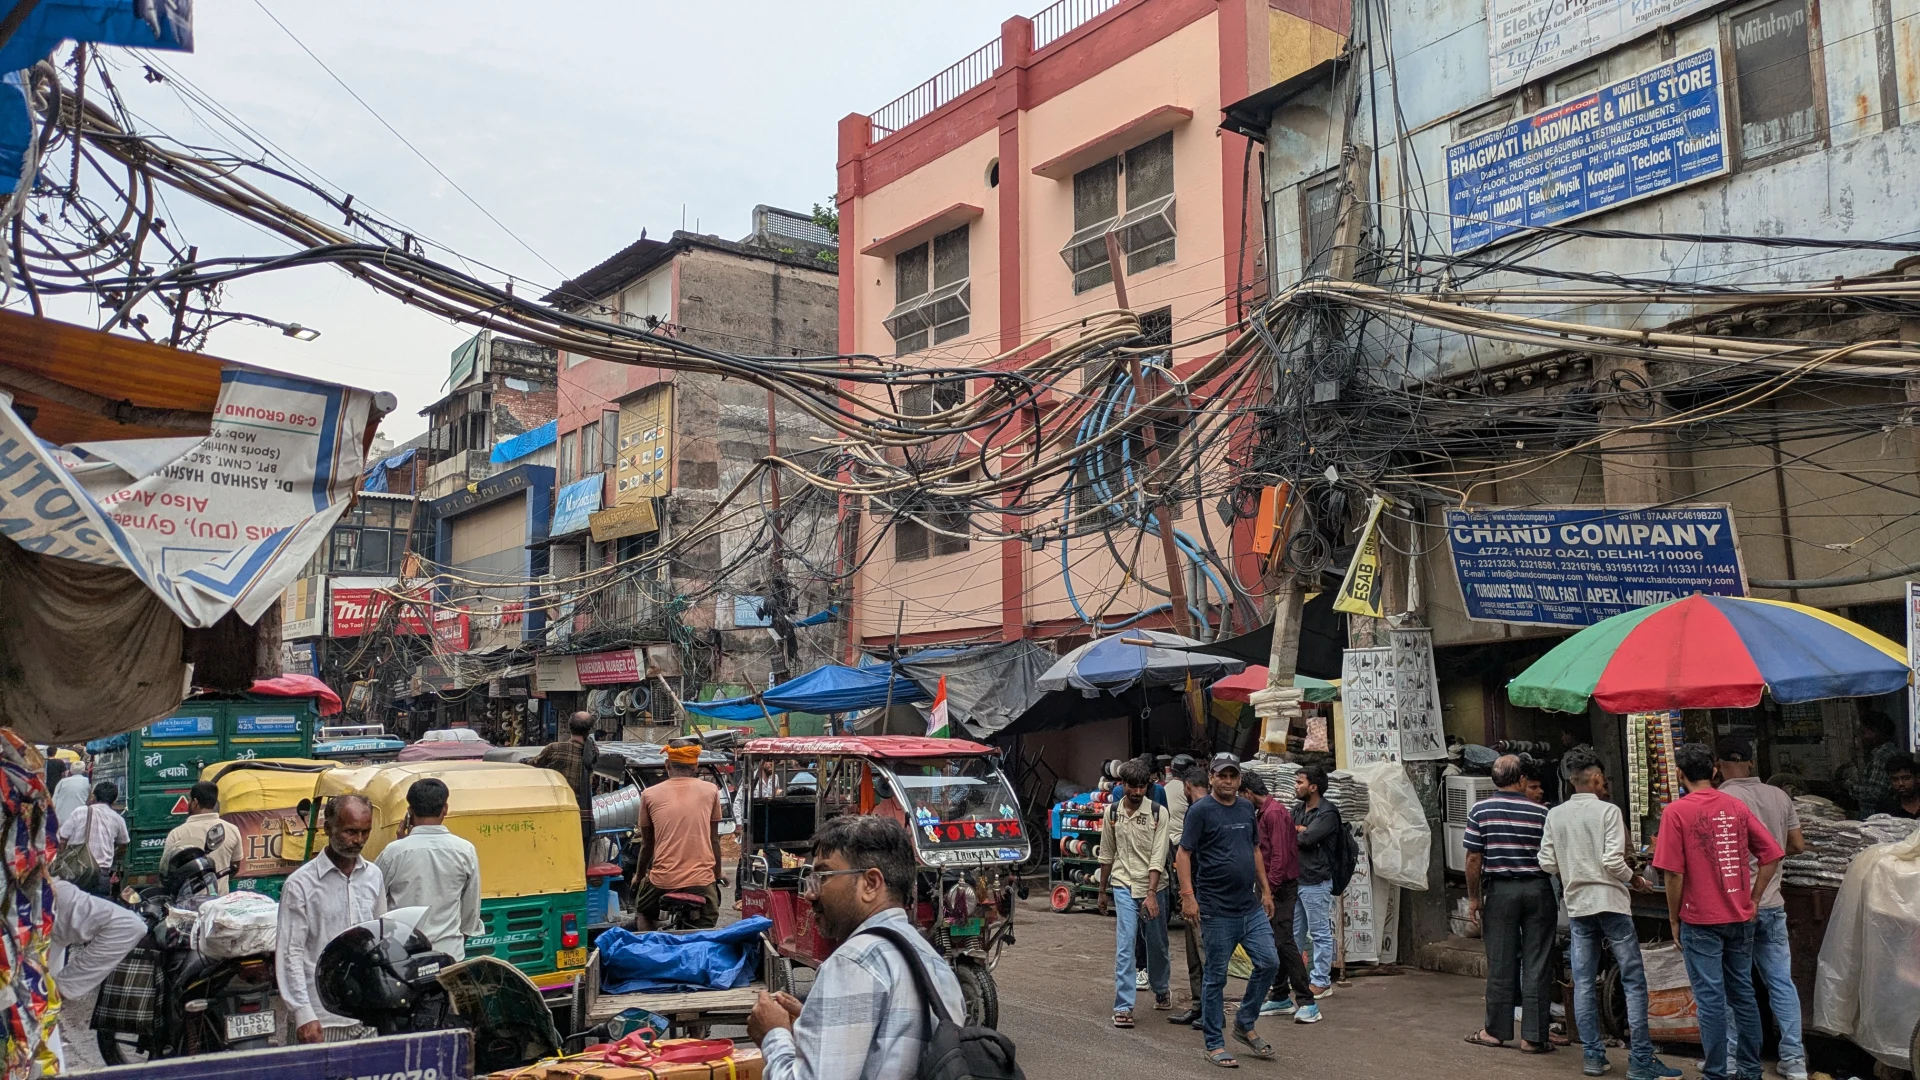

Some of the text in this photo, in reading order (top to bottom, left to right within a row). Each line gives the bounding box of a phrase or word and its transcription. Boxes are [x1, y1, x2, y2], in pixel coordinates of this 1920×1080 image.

[1612, 80, 1636, 97] MOBILE
[1540, 98, 1596, 123] FIRST FLOOR
[1451, 65, 1712, 176] BHAGWATI HARDWARE & MILL STORE
[1509, 152, 1544, 171] PRECISION
[1544, 136, 1584, 156] MEASURING
[1585, 133, 1591, 143] &
[1592, 122, 1621, 140] TESTING
[1623, 104, 1676, 129] INSTRUMENTS
[1449, 147, 1466, 158] GSTIN
[1483, 177, 1508, 193] FLOOR,
[1510, 170, 1524, 182] OLD
[1525, 163, 1543, 177] POST
[1544, 155, 1571, 170] OFFICE
[1571, 141, 1609, 160] BUILDING,
[1610, 131, 1632, 148] HAUZ
[1633, 125, 1655, 142] QAZI,
[1656, 105, 1712, 131] DELHI-110006
[1476, 193, 1495, 206] E-mail
[1589, 155, 1600, 167] PH
[1651, 126, 1684, 146] 66405958
[1632, 145, 1672, 171] Teclock
[1587, 162, 1626, 187] Kroeplin
[1493, 195, 1523, 218] IMADA
[225, 404, 317, 427] C-50 GROUND
[226, 428, 257, 443] Mob:
[240, 445, 281, 460] (Sports
[216, 454, 252, 470] CNMT,
[255, 461, 278, 474] BPT,
[210, 473, 269, 490] ASHHAD
[274, 479, 294, 493] Dr.
[160, 492, 209, 513] Also
[1491, 512, 1556, 524] www.chandcompany.in
[184, 518, 239, 541] (DU),
[1453, 523, 1721, 546] CHAND COMPANY
[1478, 547, 1704, 560] 4772, HAUZ QAZI, DELHI-110006
[1460, 559, 1472, 568] PH
[1478, 559, 1519, 570] 23213236,
[1520, 560, 1560, 571] 23218581,
[1561, 561, 1605, 573] 23216796,
[1605, 562, 1659, 574] 9319511221
[1667, 564, 1697, 573] 11331
[1705, 564, 1736, 574] 11441
[1354, 563, 1374, 602] ESAB
[1463, 569, 1486, 578] E-mail
[1491, 569, 1584, 582] info@chandcompany.com
[1586, 572, 1618, 583] Website
[1624, 575, 1735, 588] www.chandcompany.com
[1474, 583, 1511, 598] TURQUOISE
[1511, 584, 1534, 599] TOOLS
[1537, 585, 1559, 601] TOOL
[1559, 586, 1579, 602] FAST
[1587, 587, 1622, 604] APEX
[1593, 607, 1604, 615] ALL
[144, 752, 163, 768] बेटी
[158, 763, 189, 779] बचाओ
[1136, 815, 1147, 826] 66
[249, 862, 275, 870] Premium
